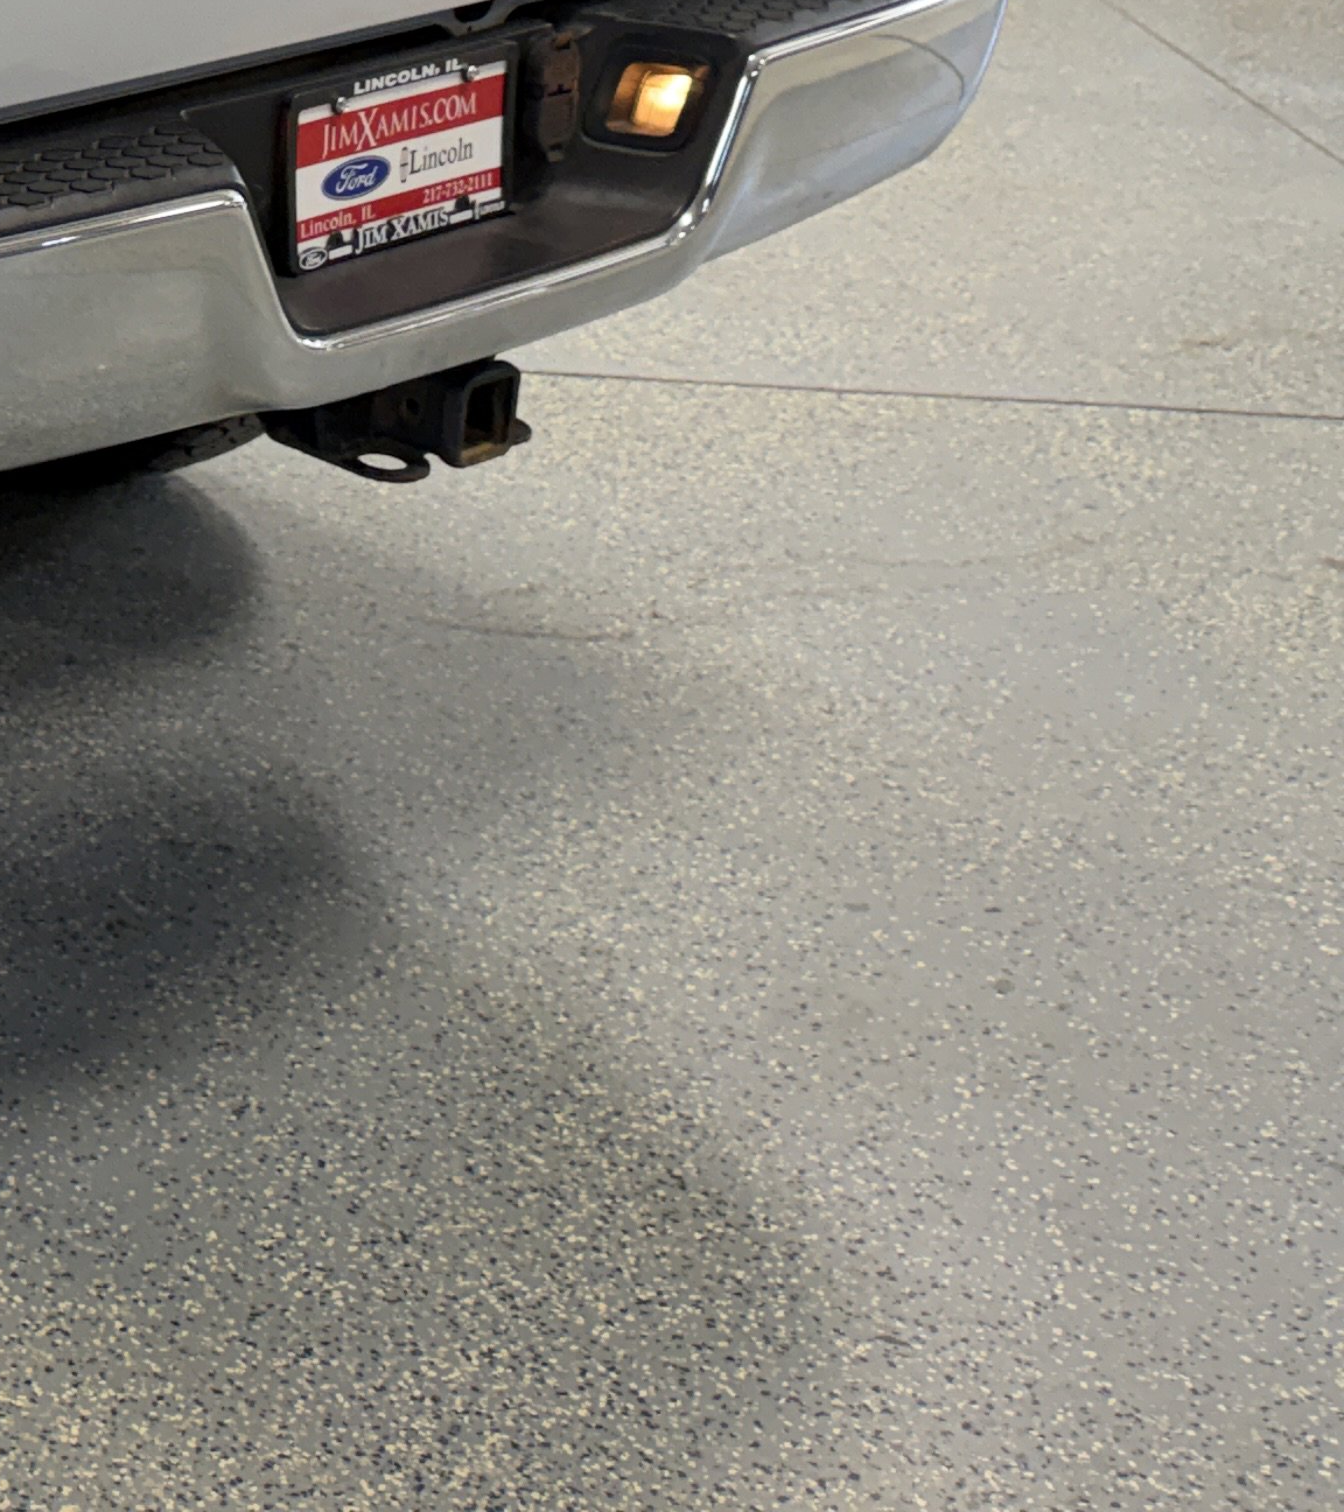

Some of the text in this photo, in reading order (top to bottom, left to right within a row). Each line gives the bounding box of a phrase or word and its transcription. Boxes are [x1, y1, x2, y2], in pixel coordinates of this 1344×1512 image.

[354, 64, 440, 93] LINCOLN,
[409, 136, 473, 176] Lincoln
[335, 163, 378, 194] Ford
[422, 172, 494, 204] 217-732-2111
[361, 204, 376, 222] IL
[355, 209, 450, 254] JIM XAMIS
